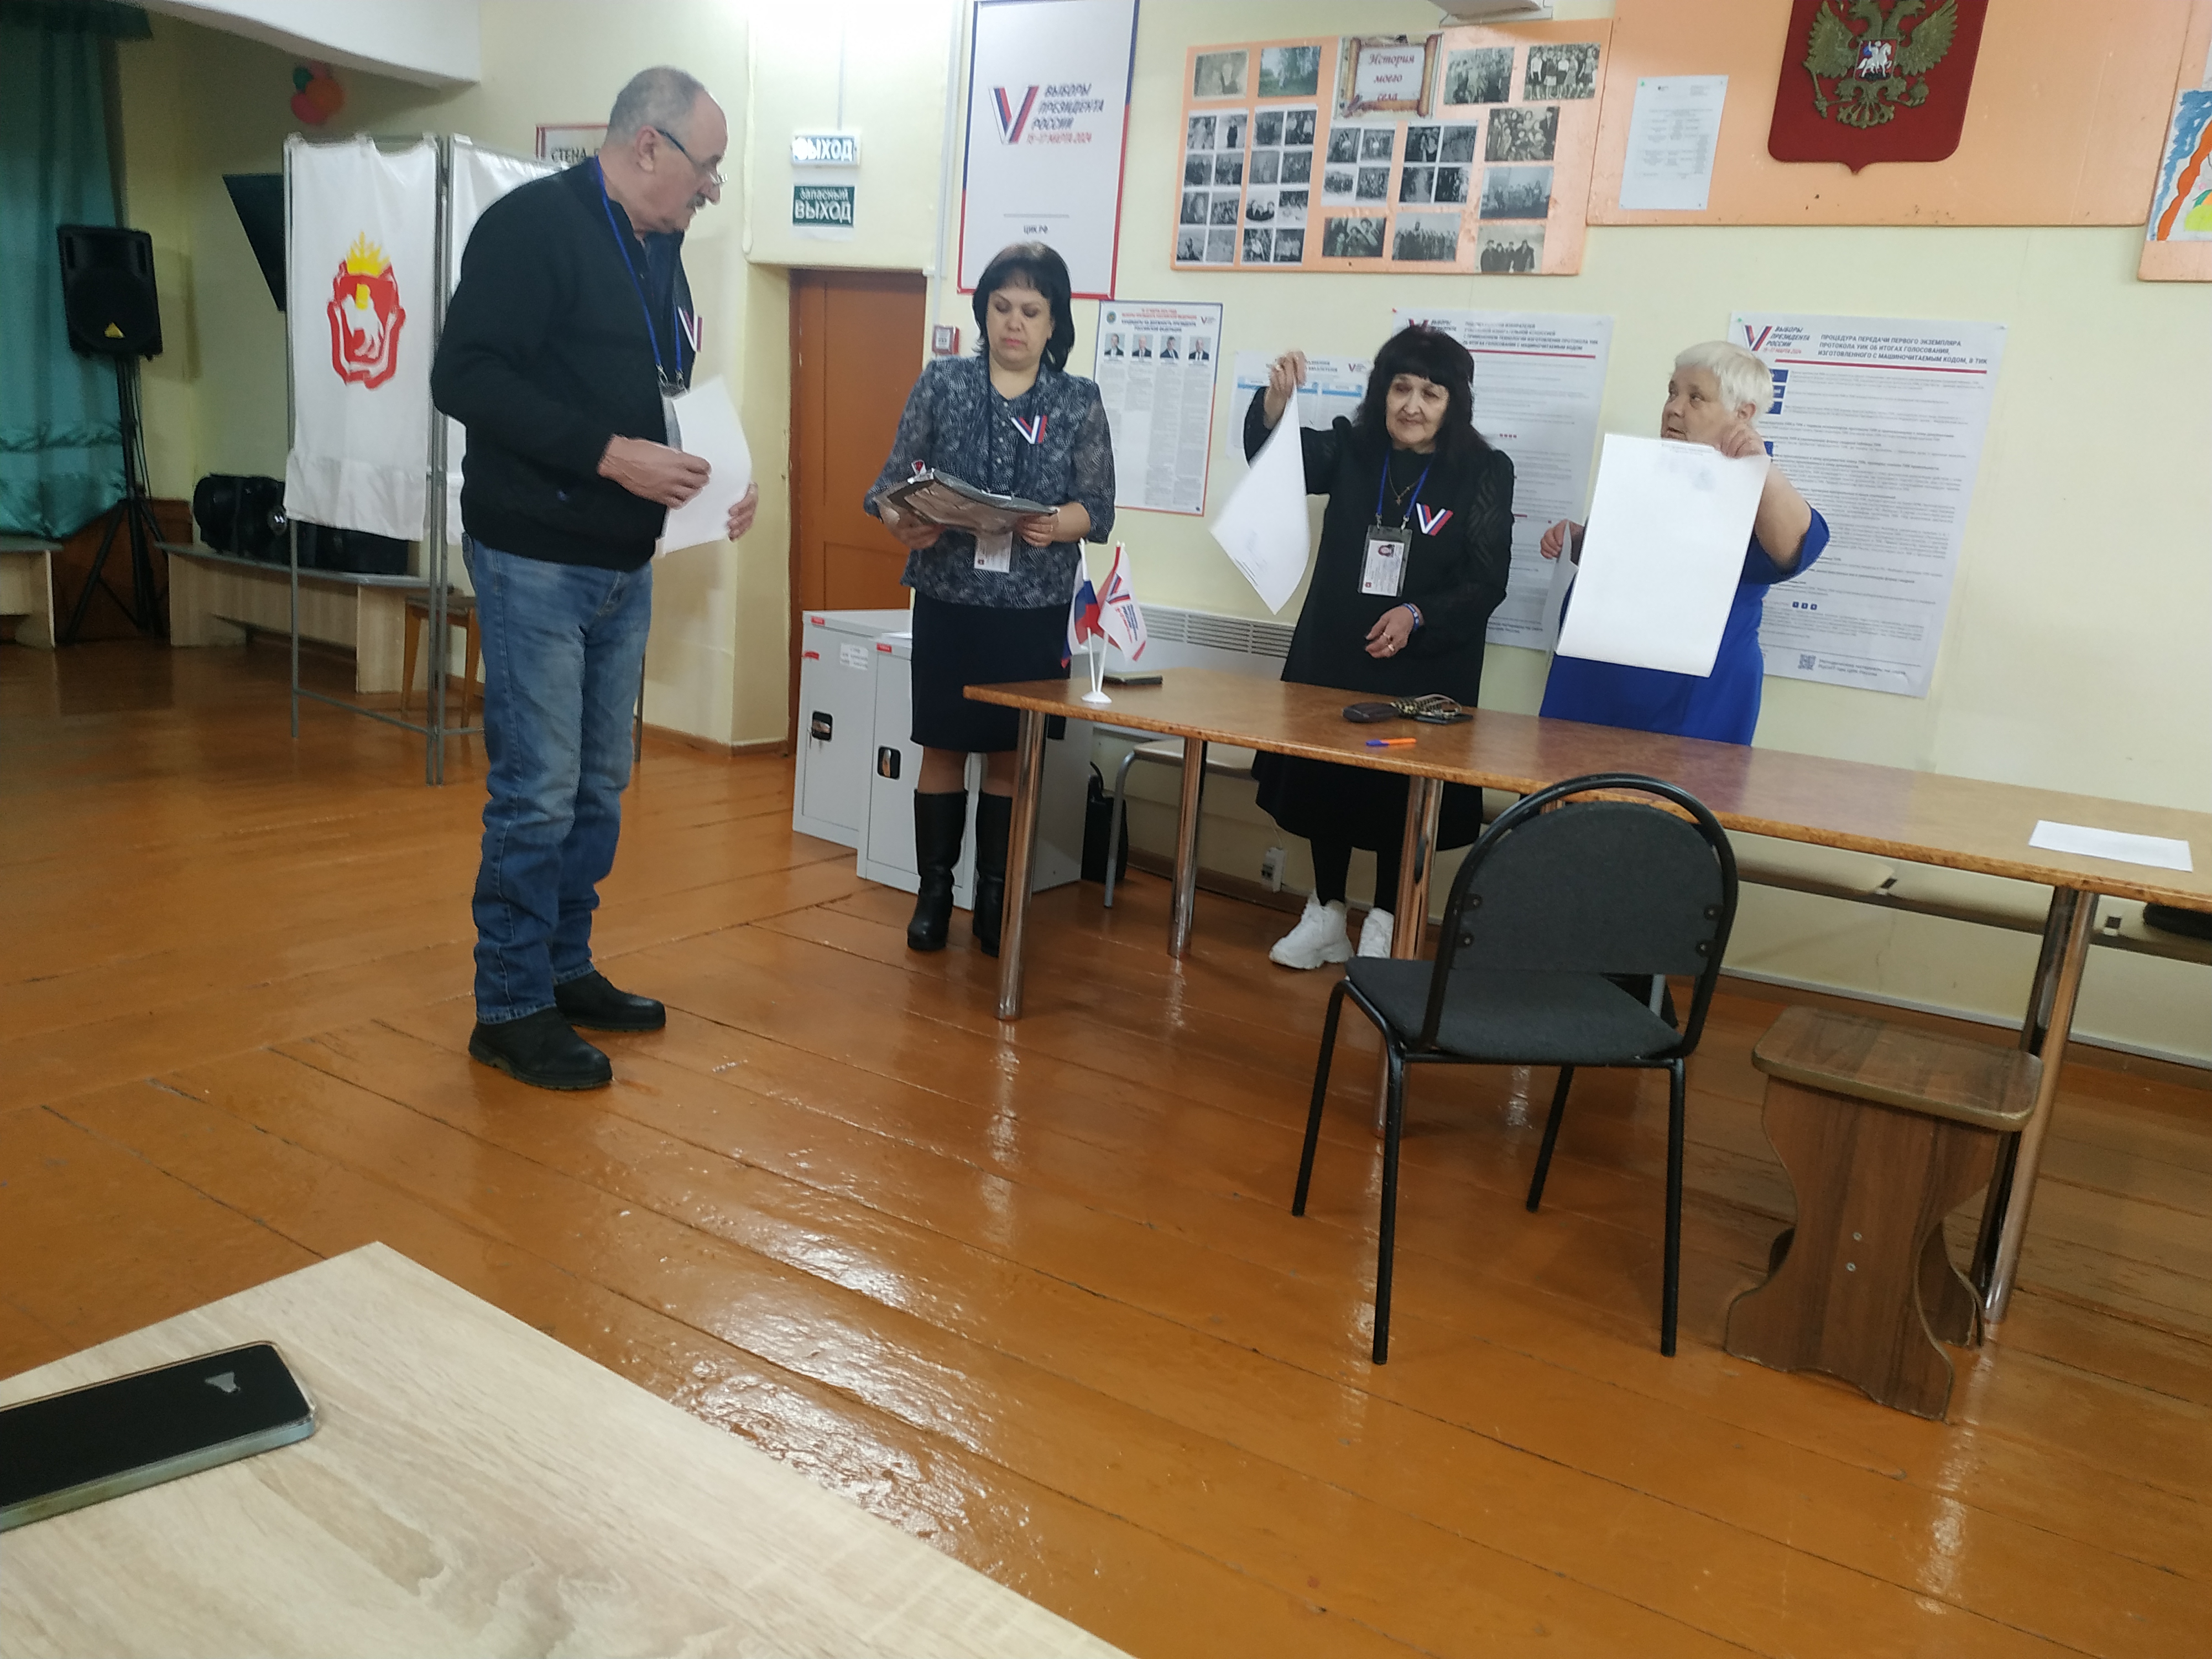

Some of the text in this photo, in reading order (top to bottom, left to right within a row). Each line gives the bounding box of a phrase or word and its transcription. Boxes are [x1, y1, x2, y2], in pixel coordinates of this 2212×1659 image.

[1368, 54, 1415, 67] История
[1374, 74, 1402, 83] моего
[1045, 84, 1092, 97] ВЫБОРЫ
[1377, 93, 1398, 101] села
[1031, 117, 1074, 131] РОССИИ
[792, 137, 853, 161] ЫХОД
[800, 187, 848, 200] ЗАПАСНЫЙ
[795, 200, 851, 223] ВЫХОД
[1024, 225, 1037, 234] ЦИК
[1770, 333, 1811, 341] ПРЕЗИДЕНТА
[1818, 350, 1872, 358] ИЗГОТОВЛЕННОГО
[1878, 353, 1942, 362] МАШИНОЧИТАЕМЫМ
